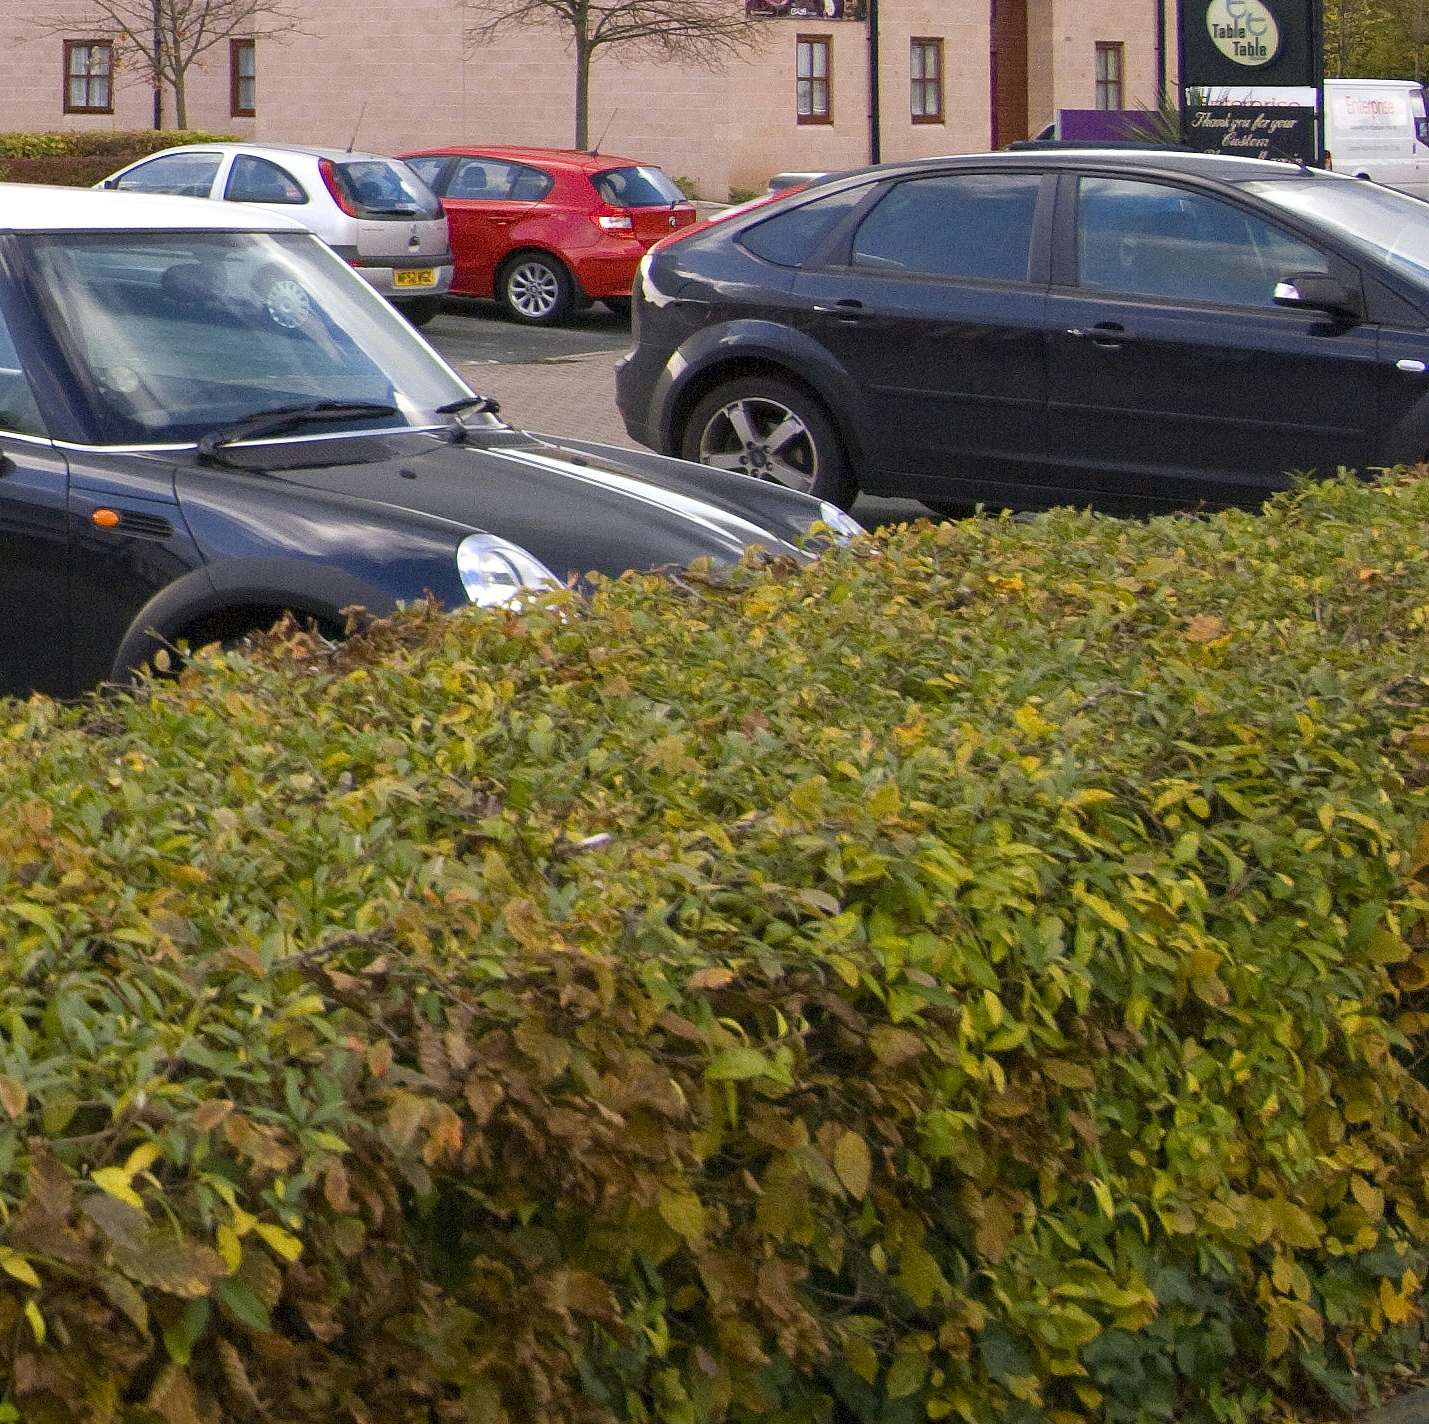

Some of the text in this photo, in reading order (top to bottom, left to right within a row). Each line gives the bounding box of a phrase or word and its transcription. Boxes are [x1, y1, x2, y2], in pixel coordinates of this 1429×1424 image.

[1212, 18, 1245, 39] Table
[1232, 37, 1267, 56] Table
[1191, 112, 1297, 133] Thank you for your
[1222, 131, 1269, 147] Custom
